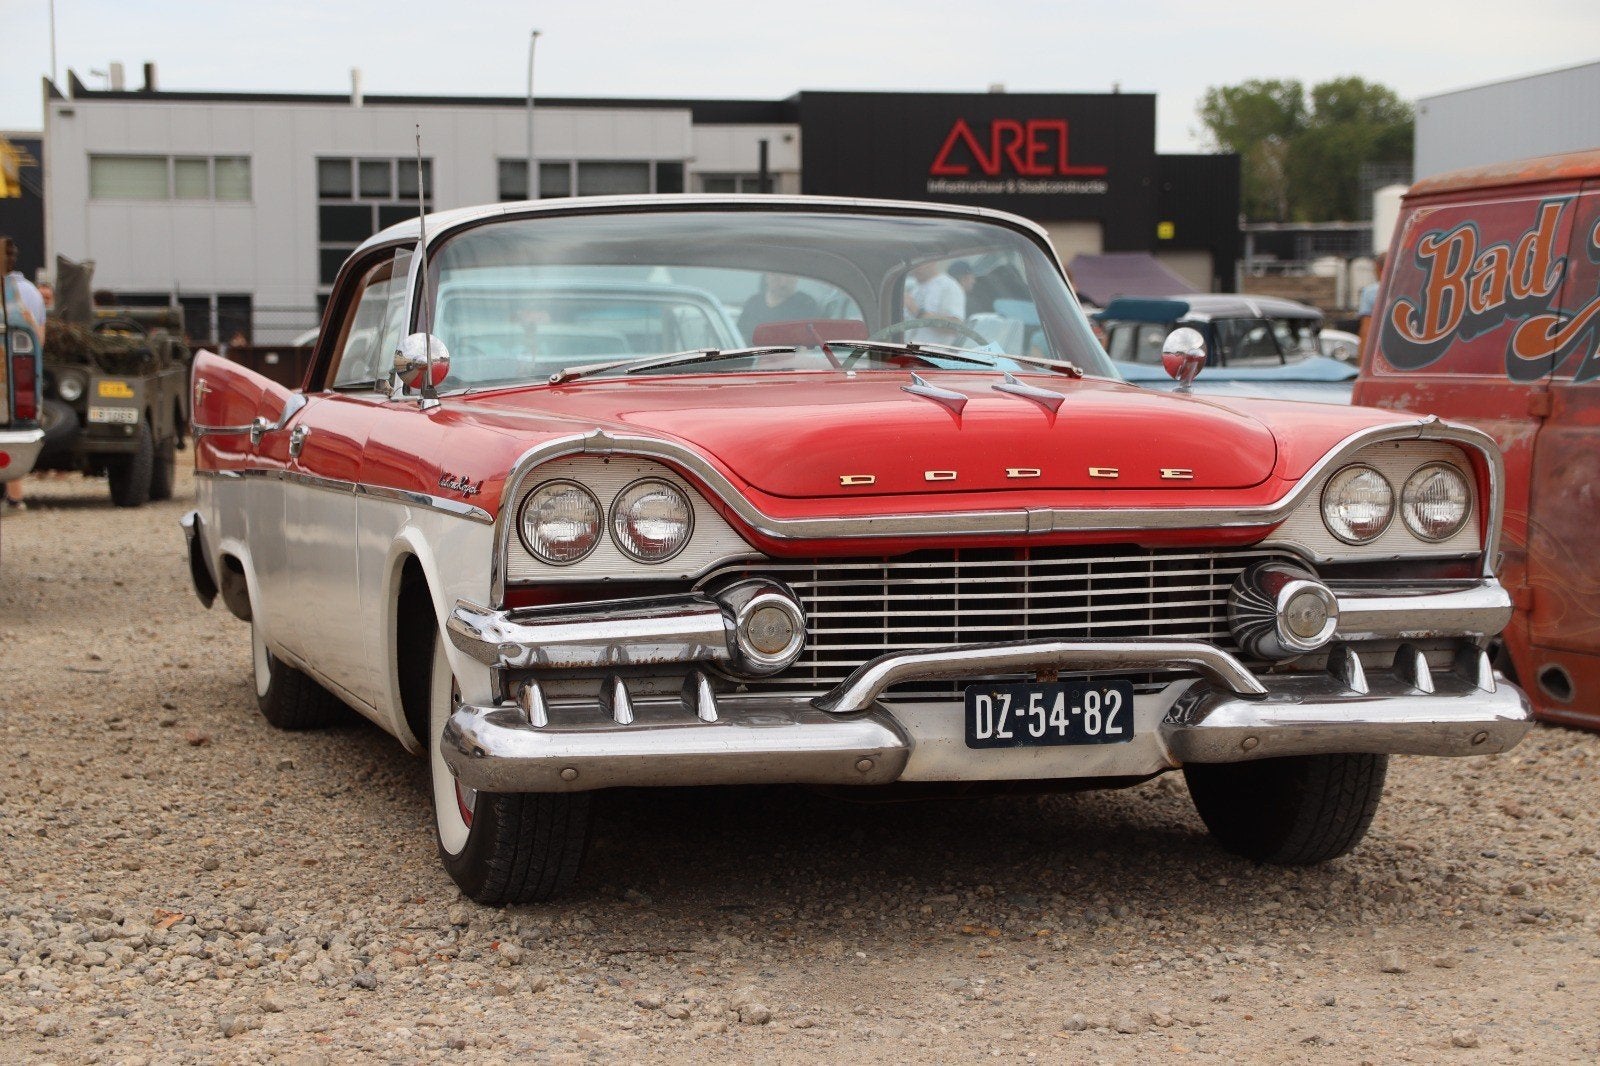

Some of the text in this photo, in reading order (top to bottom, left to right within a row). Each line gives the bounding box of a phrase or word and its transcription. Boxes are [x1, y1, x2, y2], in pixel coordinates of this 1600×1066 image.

[929, 118, 1108, 175] AREL
[1392, 202, 1565, 345] Bad
[975, 689, 1123, 740] DZ-54-82
